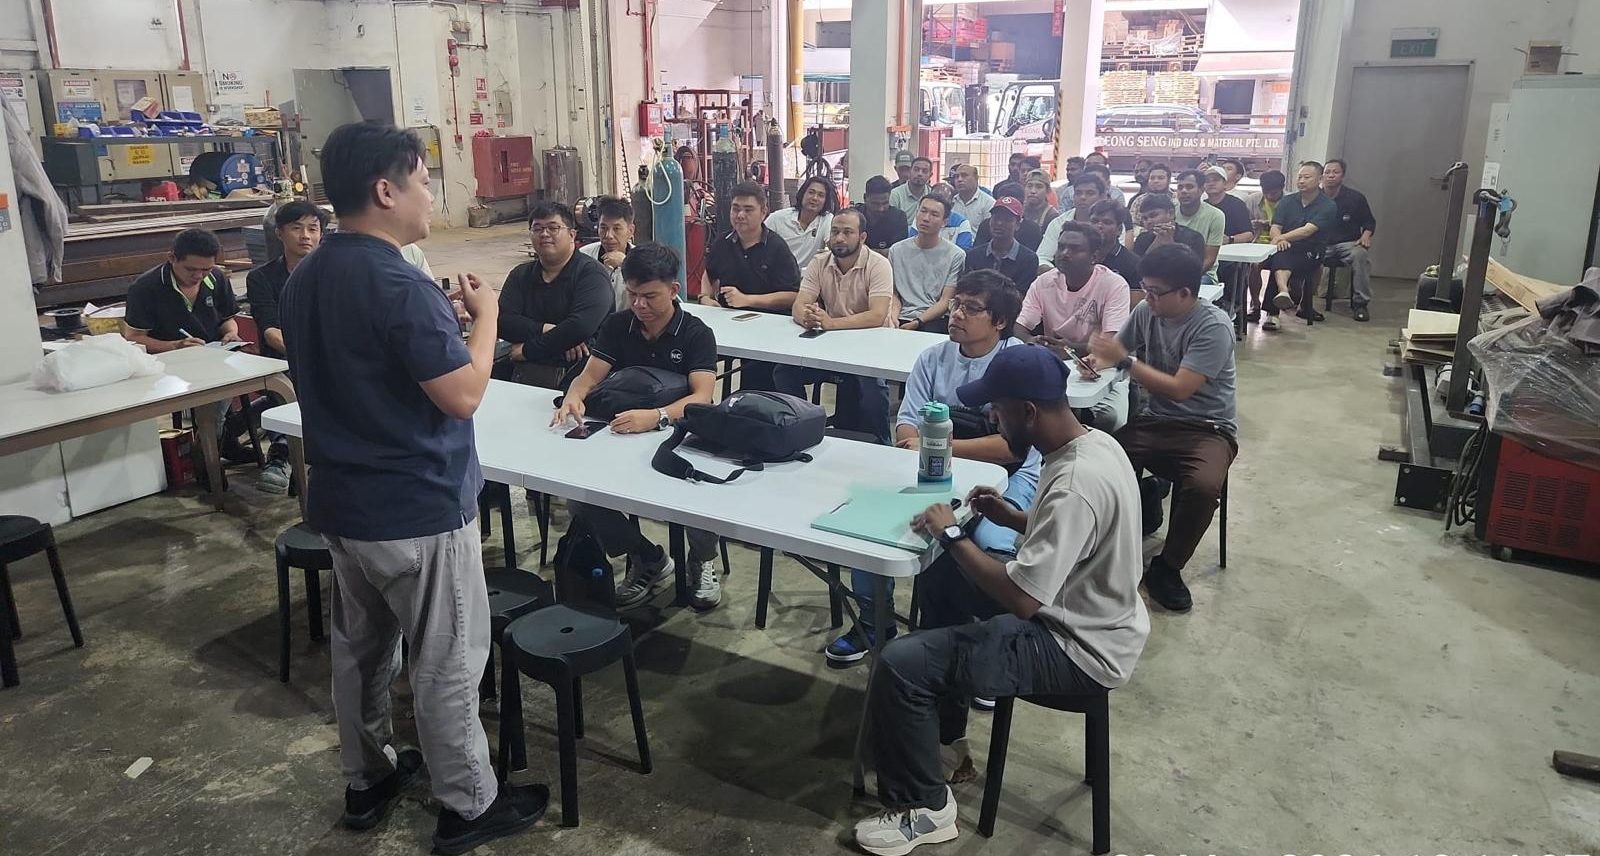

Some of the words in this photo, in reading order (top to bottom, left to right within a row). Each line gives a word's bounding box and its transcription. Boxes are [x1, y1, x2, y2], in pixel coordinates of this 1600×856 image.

[1400, 41, 1425, 56] EXIT
[1136, 135, 1167, 147] SENG
[1183, 138, 1199, 147] GAS
[1199, 138, 1206, 147] &
[1208, 138, 1244, 147] MATERIAL
[1264, 138, 1280, 148] LTD.
